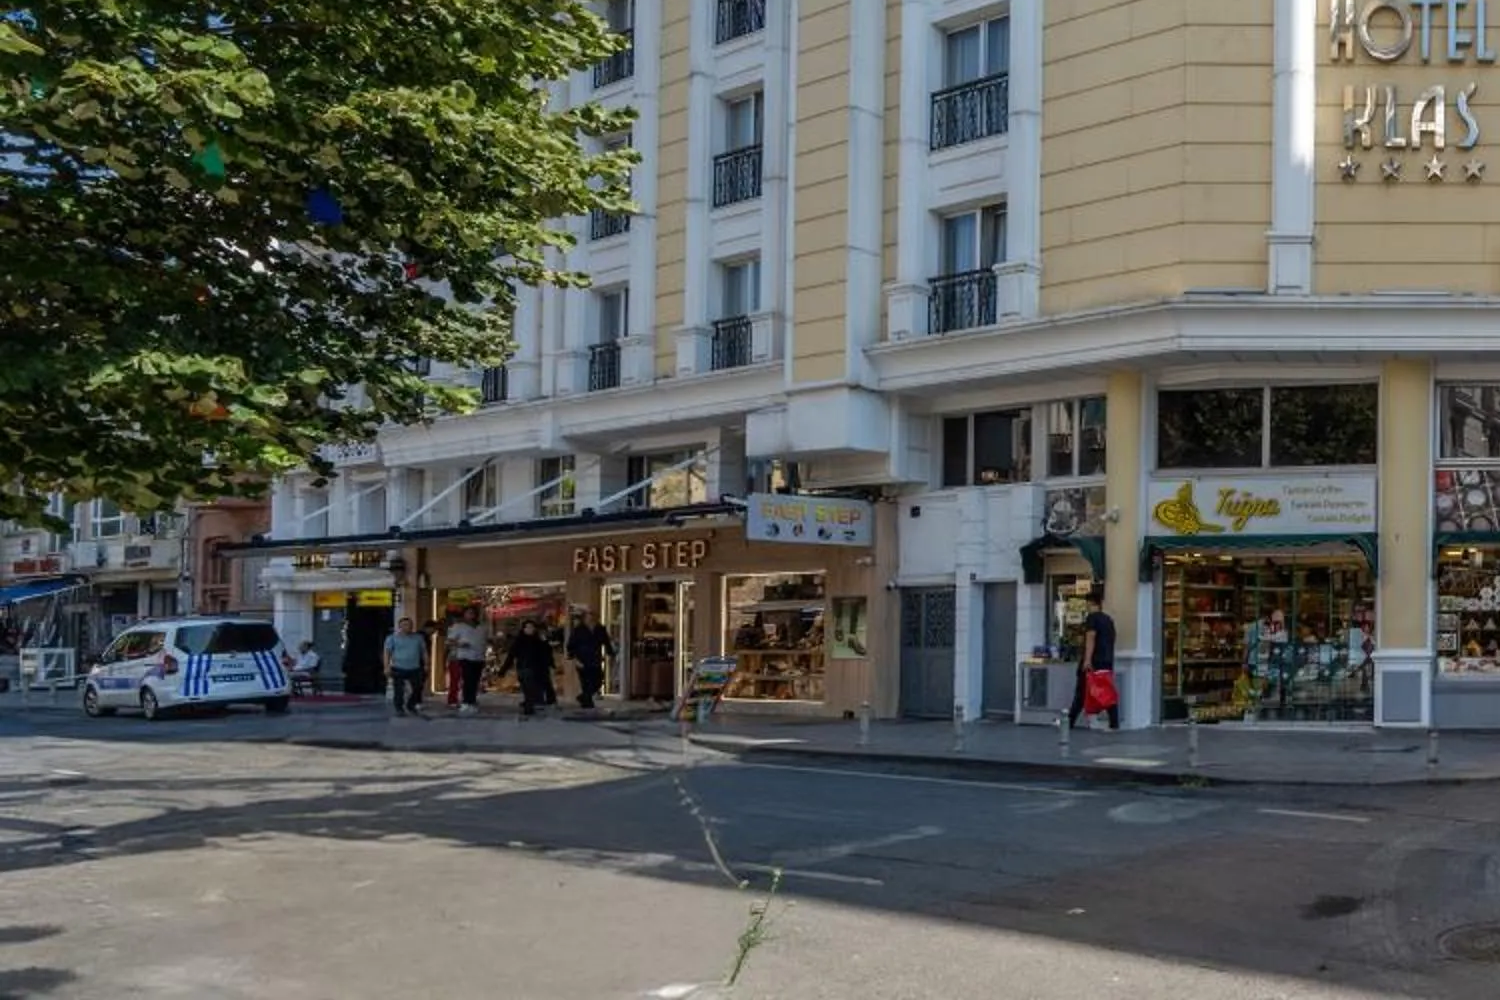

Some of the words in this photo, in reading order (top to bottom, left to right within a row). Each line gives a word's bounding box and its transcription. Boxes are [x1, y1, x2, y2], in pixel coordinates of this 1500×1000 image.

[1343, 81, 1481, 151] KLAS
[815, 505, 861, 525] STEP
[572, 544, 632, 573] FAST
[641, 539, 706, 569] STEP
